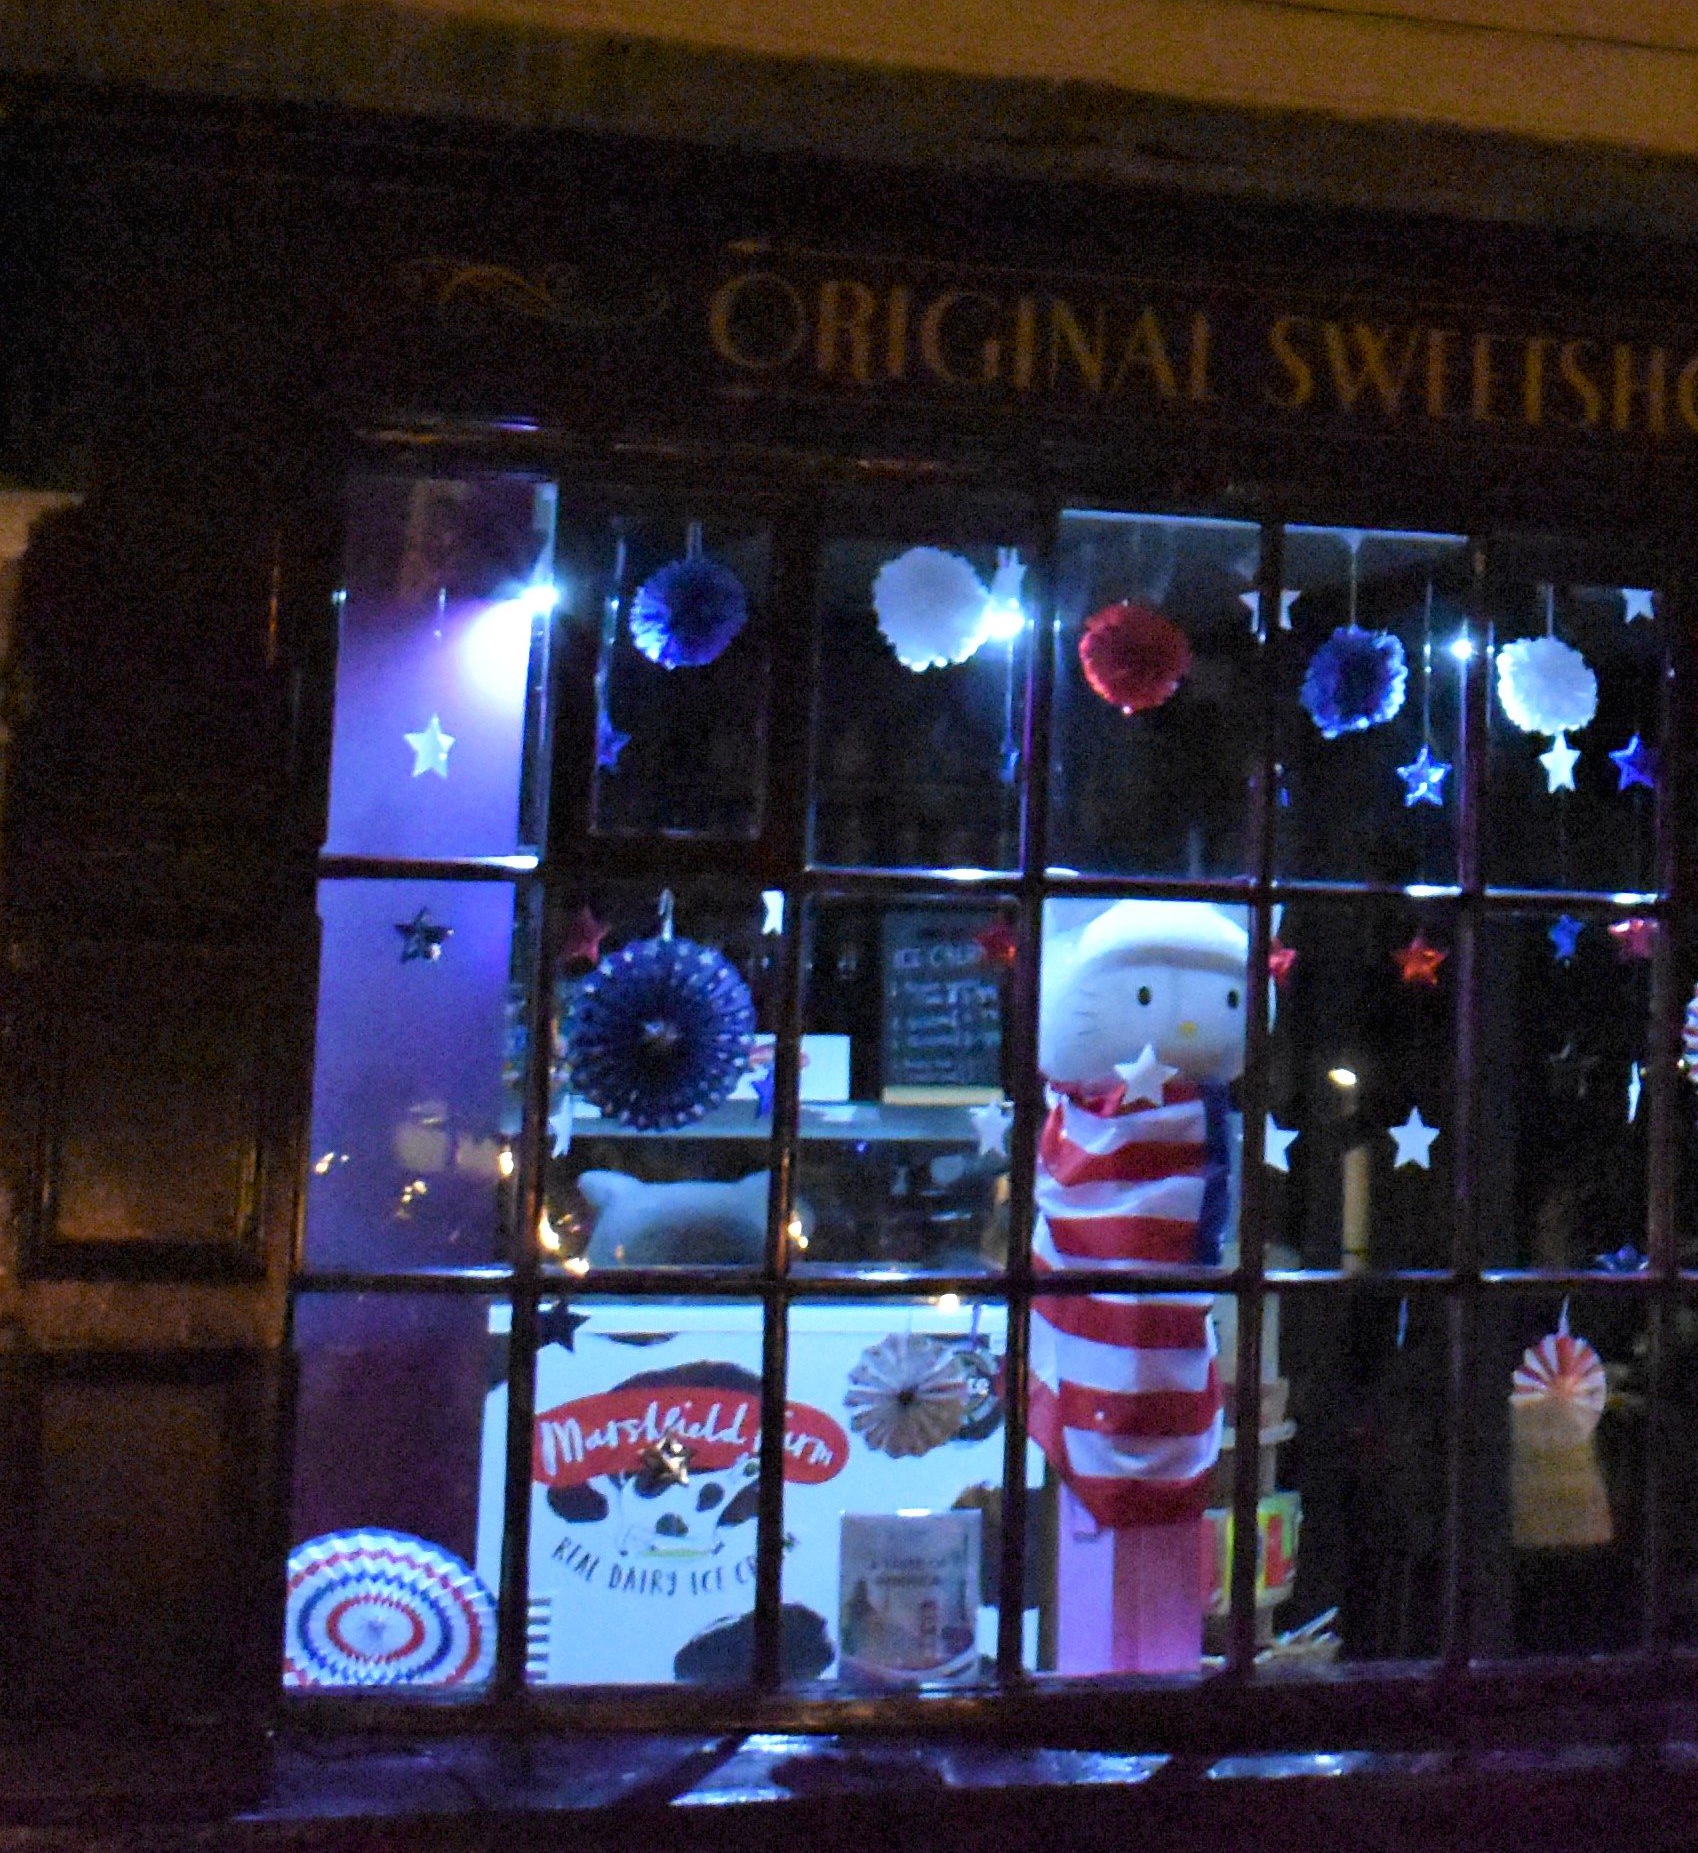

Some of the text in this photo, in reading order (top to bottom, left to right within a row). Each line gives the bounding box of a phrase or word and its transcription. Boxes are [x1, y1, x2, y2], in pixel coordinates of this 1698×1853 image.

[706, 268, 1217, 403] ORIGINAL
[551, 1535, 600, 1582] REAL
[608, 1562, 679, 1597] DAIRY
[690, 1565, 724, 1596] ICE
